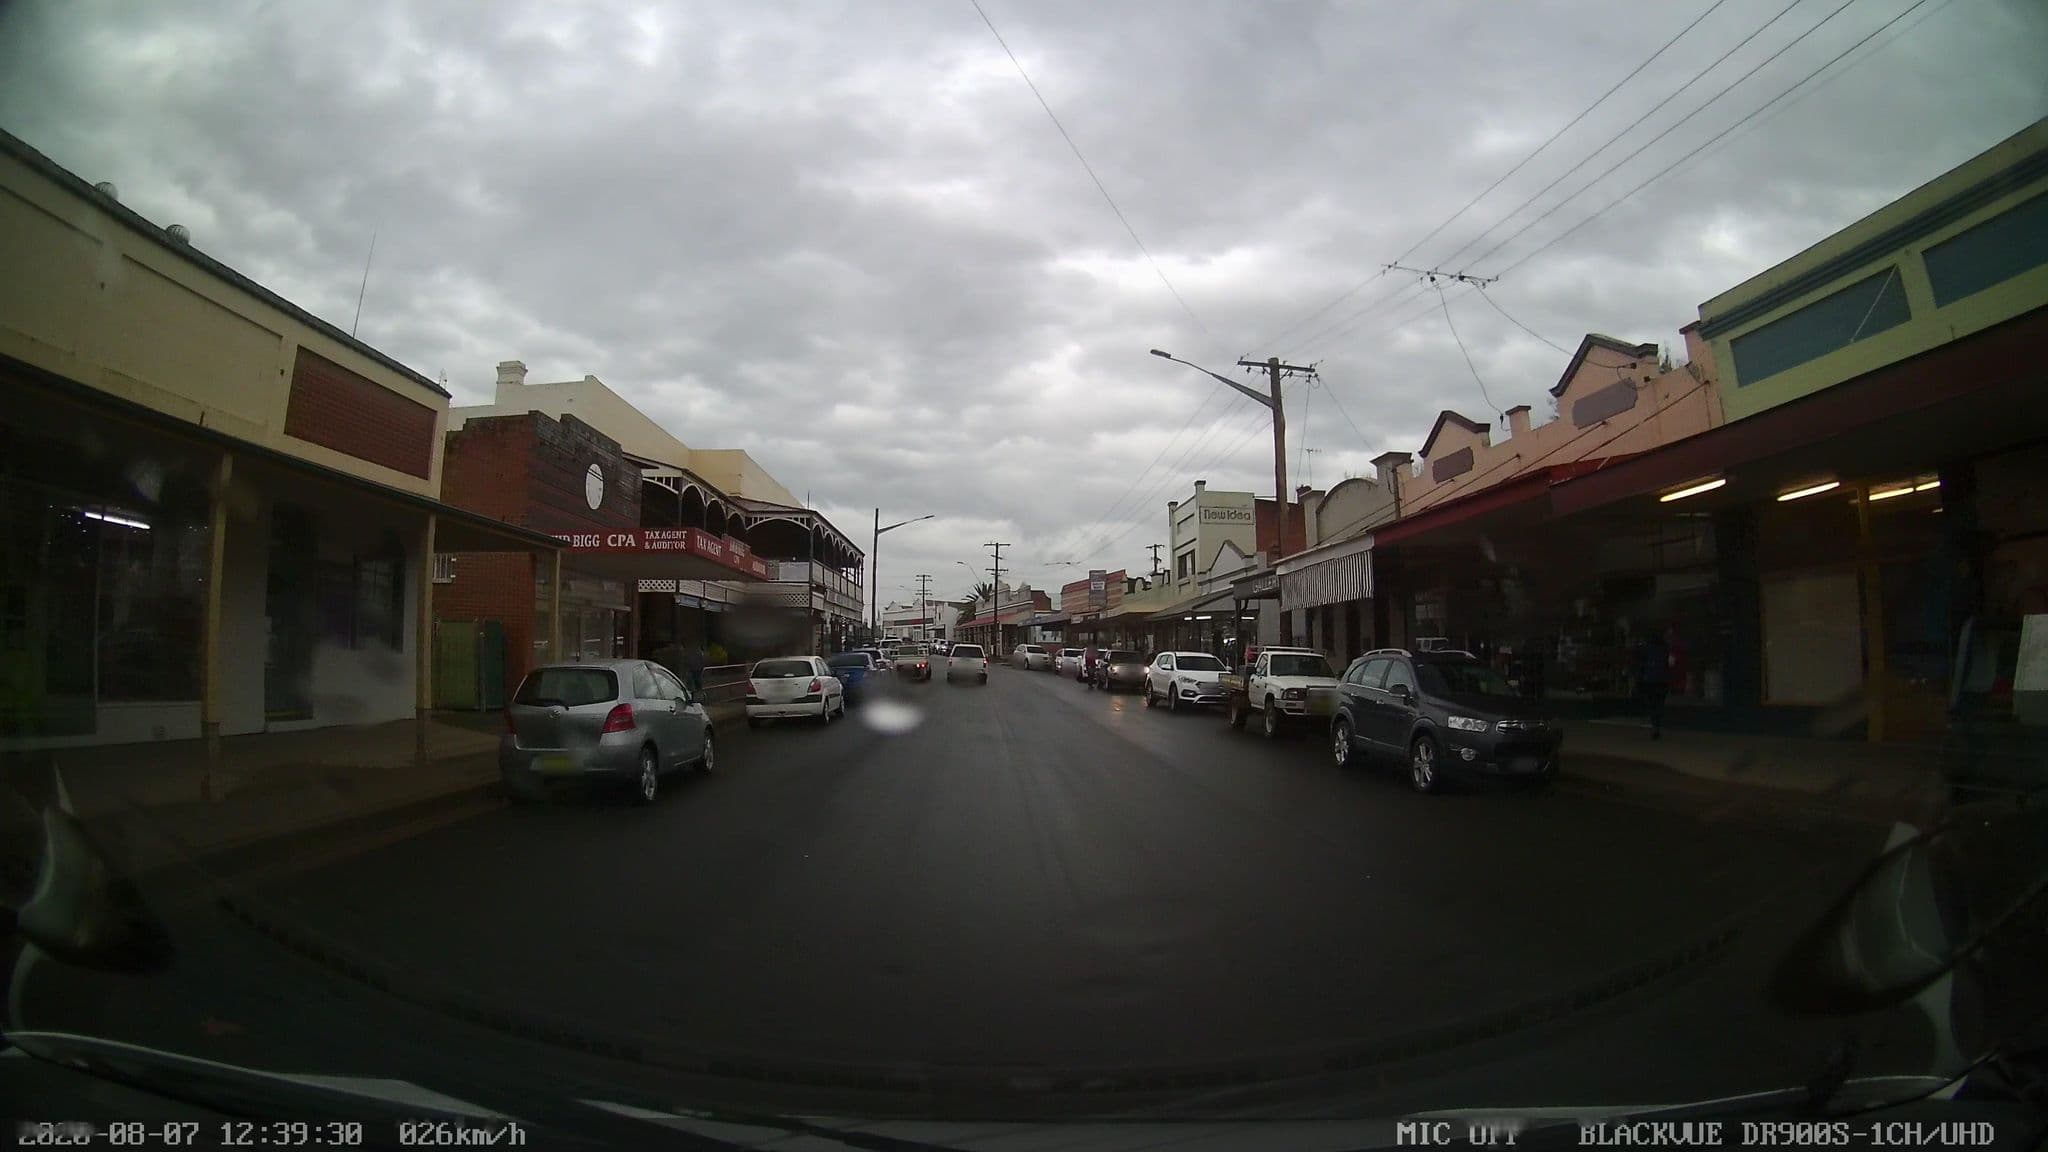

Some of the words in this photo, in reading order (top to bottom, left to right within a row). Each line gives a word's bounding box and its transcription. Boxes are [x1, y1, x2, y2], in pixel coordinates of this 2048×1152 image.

[572, 534, 600, 548] BIGG
[606, 534, 636, 547] CPA
[644, 530, 659, 540] TAX
[660, 530, 688, 540] AGENT
[644, 540, 650, 549] &
[651, 540, 686, 550] AUDITOR
[697, 535, 707, 551] TAX
[706, 540, 722, 556] AGENT
